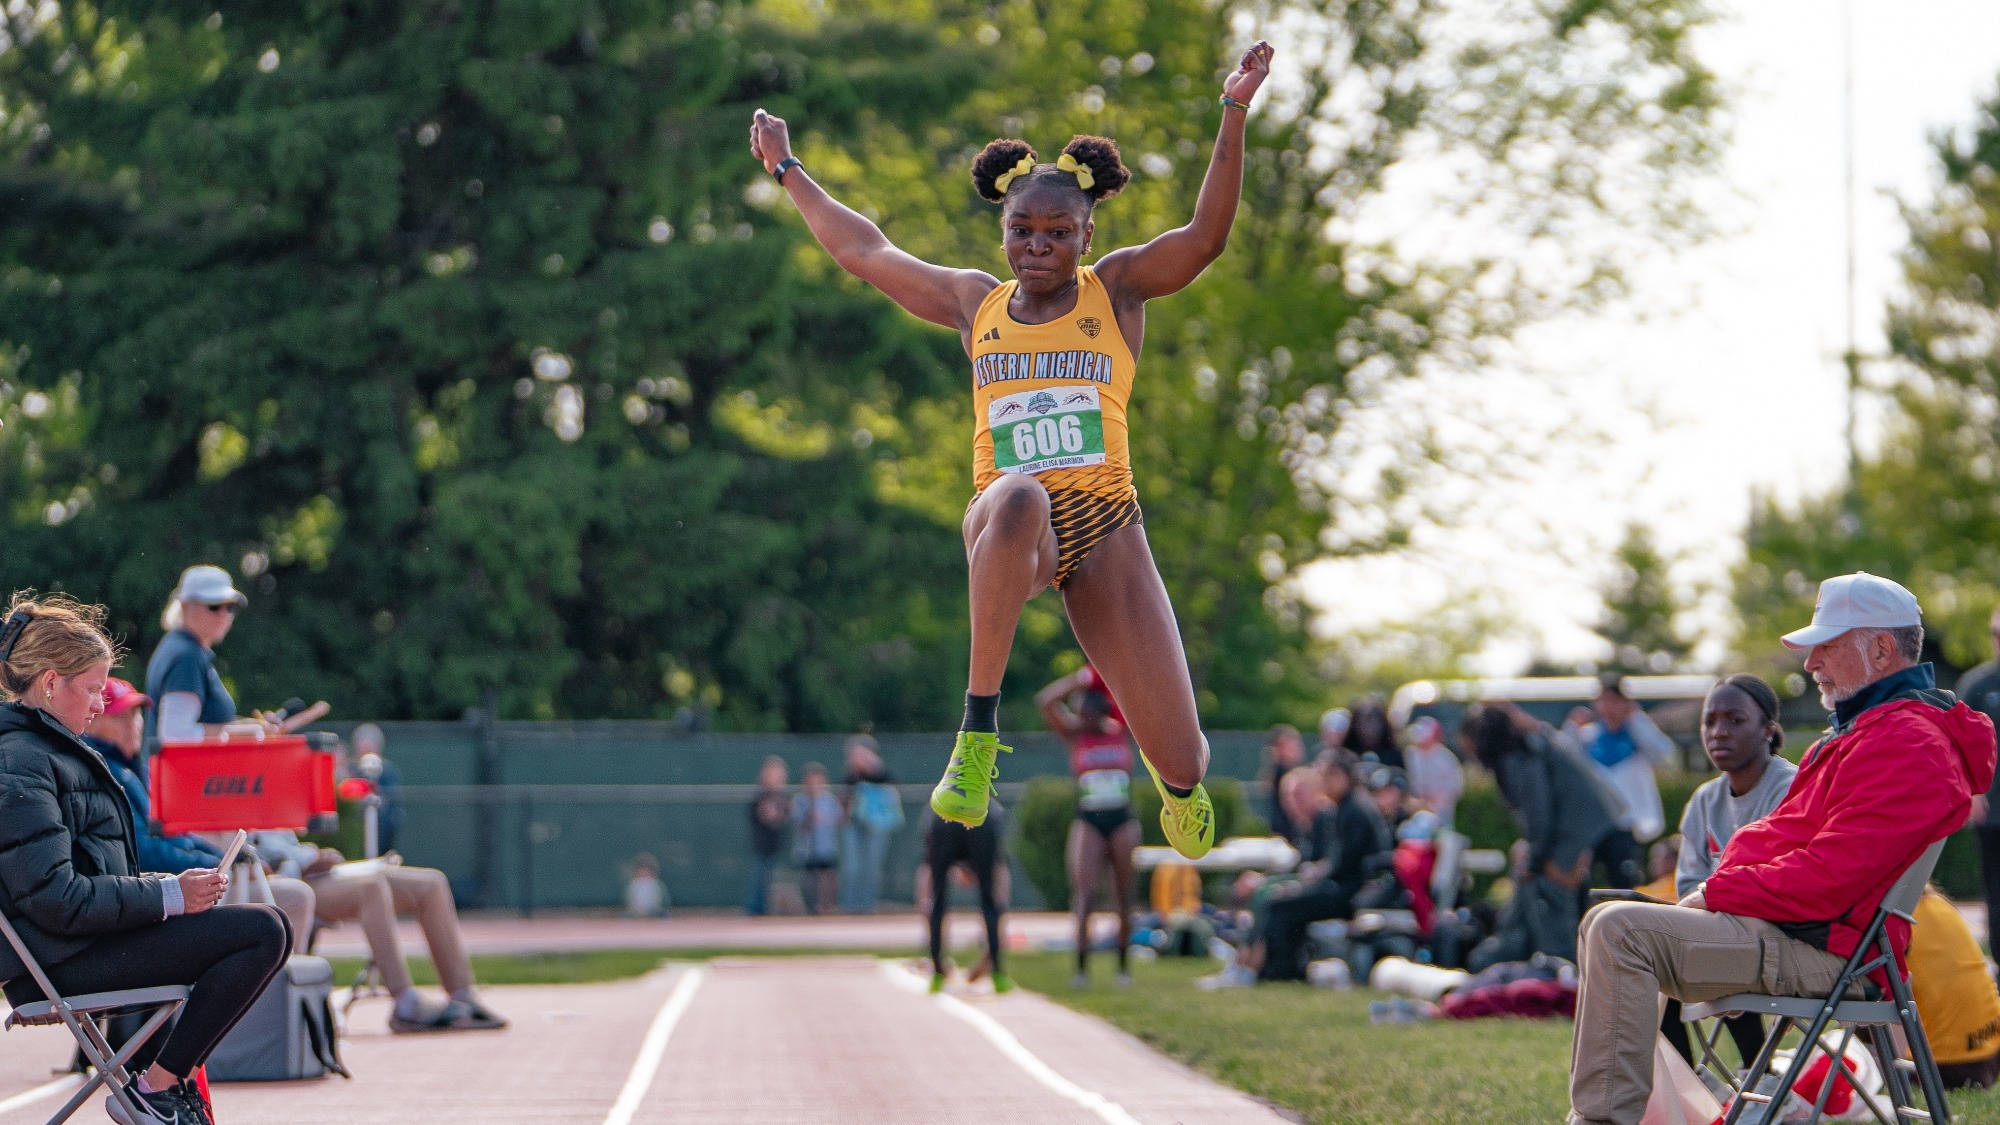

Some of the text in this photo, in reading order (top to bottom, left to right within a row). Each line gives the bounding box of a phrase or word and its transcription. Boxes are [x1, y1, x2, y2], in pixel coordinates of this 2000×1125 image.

[1033, 350, 1112, 385] MICHIGAN
[1013, 415, 1083, 461] 606
[1019, 456, 1085, 473] LAURINE ELISA MARIMON
[203, 774, 265, 795] GILL
